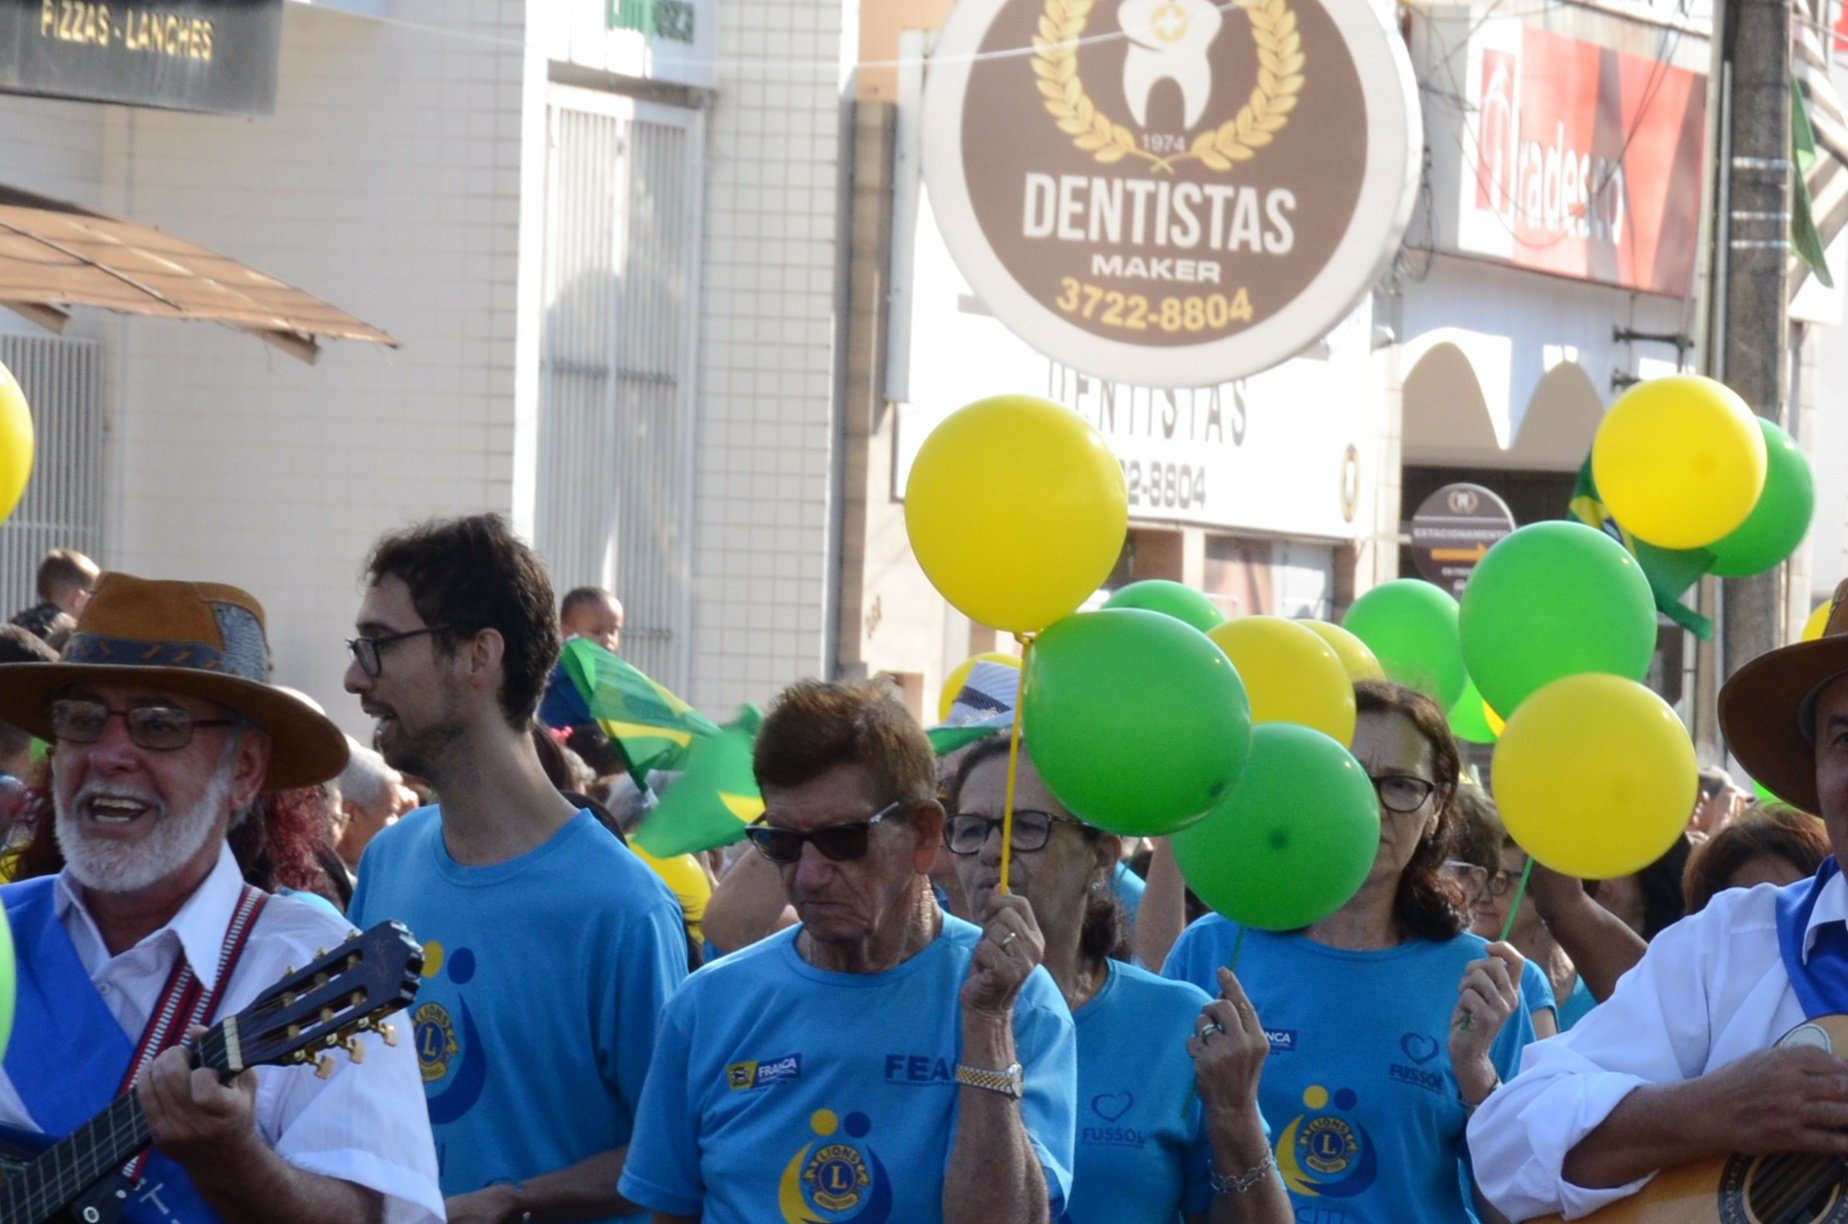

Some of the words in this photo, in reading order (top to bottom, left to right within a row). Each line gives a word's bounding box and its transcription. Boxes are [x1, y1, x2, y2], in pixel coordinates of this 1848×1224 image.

[41, 0, 110, 46] PIZZAS
[126, 8, 212, 61] LANCHES
[1141, 133, 1186, 153] 1974
[1022, 171, 1297, 256] DENTISTAS
[1091, 253, 1222, 284] MAKER
[1056, 276, 1254, 332] 3722-8804
[819, 1146, 859, 1162] LIONS
[830, 1165, 847, 1189] L
